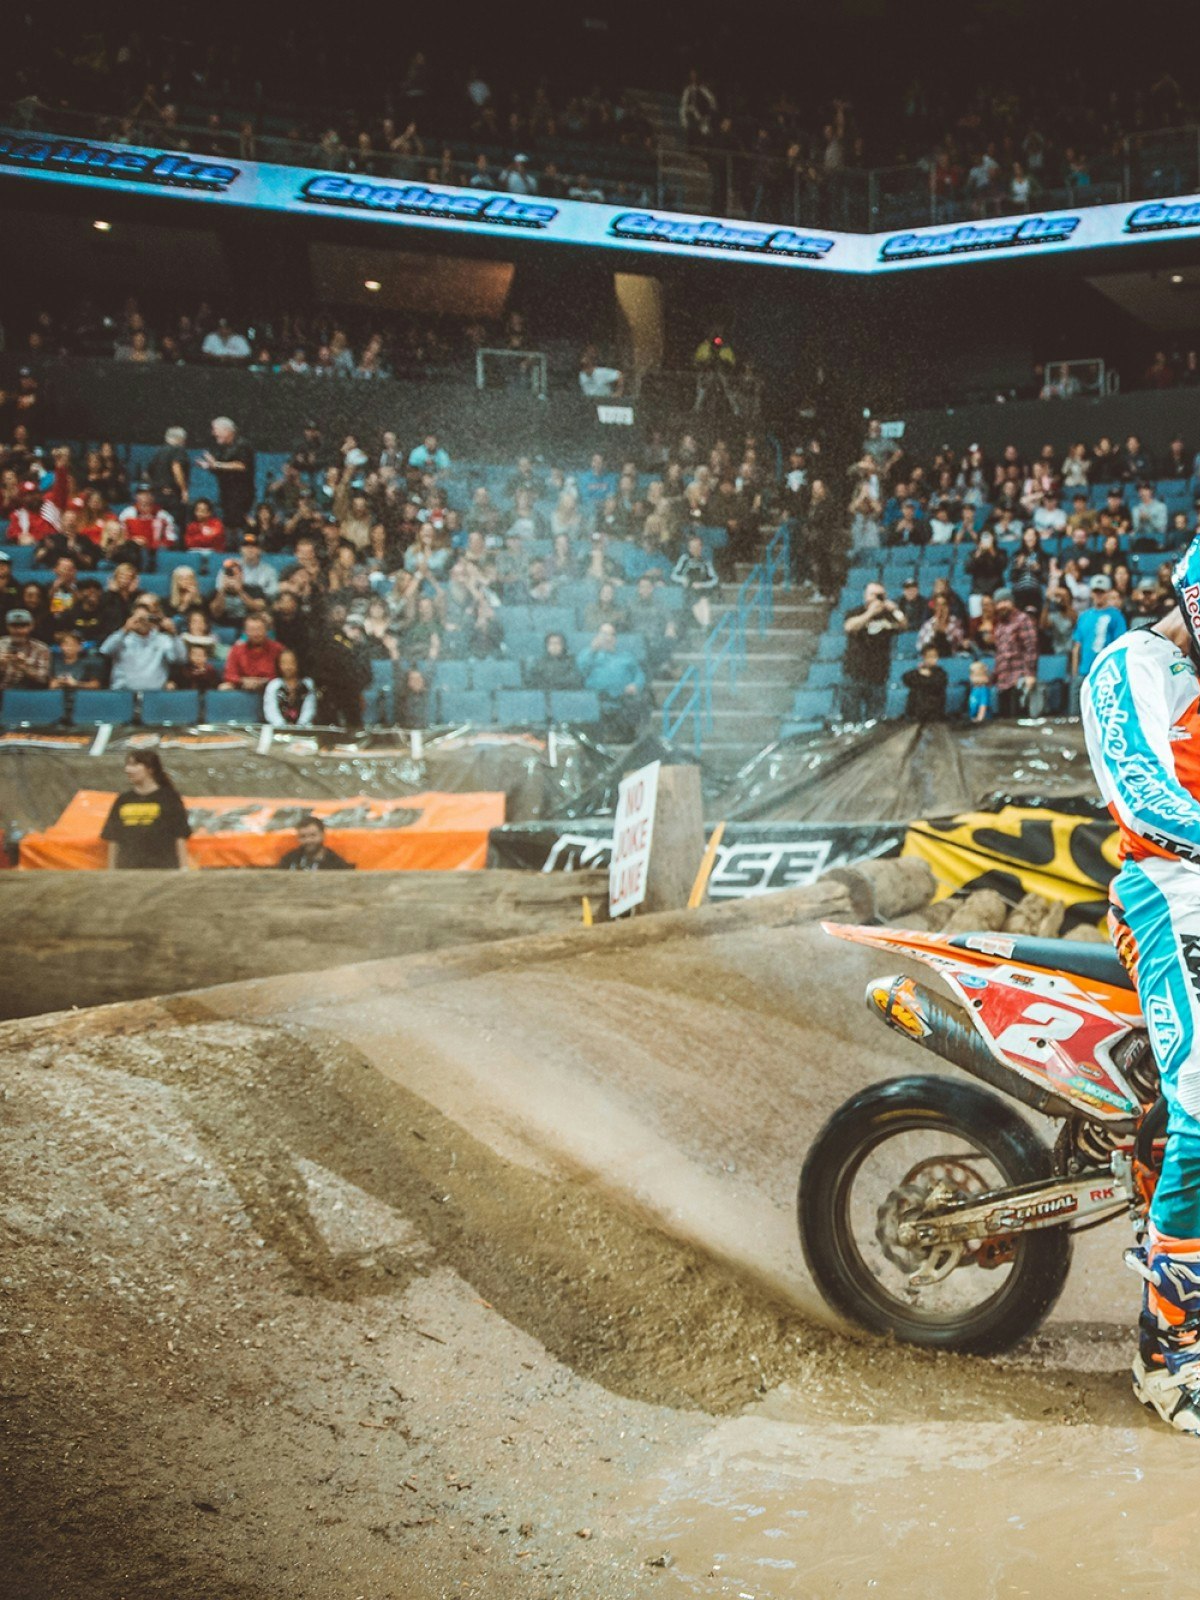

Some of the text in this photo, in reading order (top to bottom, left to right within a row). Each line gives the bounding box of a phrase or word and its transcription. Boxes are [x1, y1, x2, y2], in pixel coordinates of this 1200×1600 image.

[151, 155, 241, 185] Ice
[302, 176, 486, 217] Engine
[484, 197, 559, 222] Ice
[612, 213, 772, 248] Engine
[769, 231, 835, 253] Ice
[881, 225, 1018, 257] Engine
[1016, 217, 1080, 239] Ice
[626, 779, 645, 818] NO
[615, 817, 649, 863] JOKE
[608, 860, 644, 904] LANE
[1000, 1002, 1085, 1062] 2
[1089, 1187, 1115, 1201] RK
